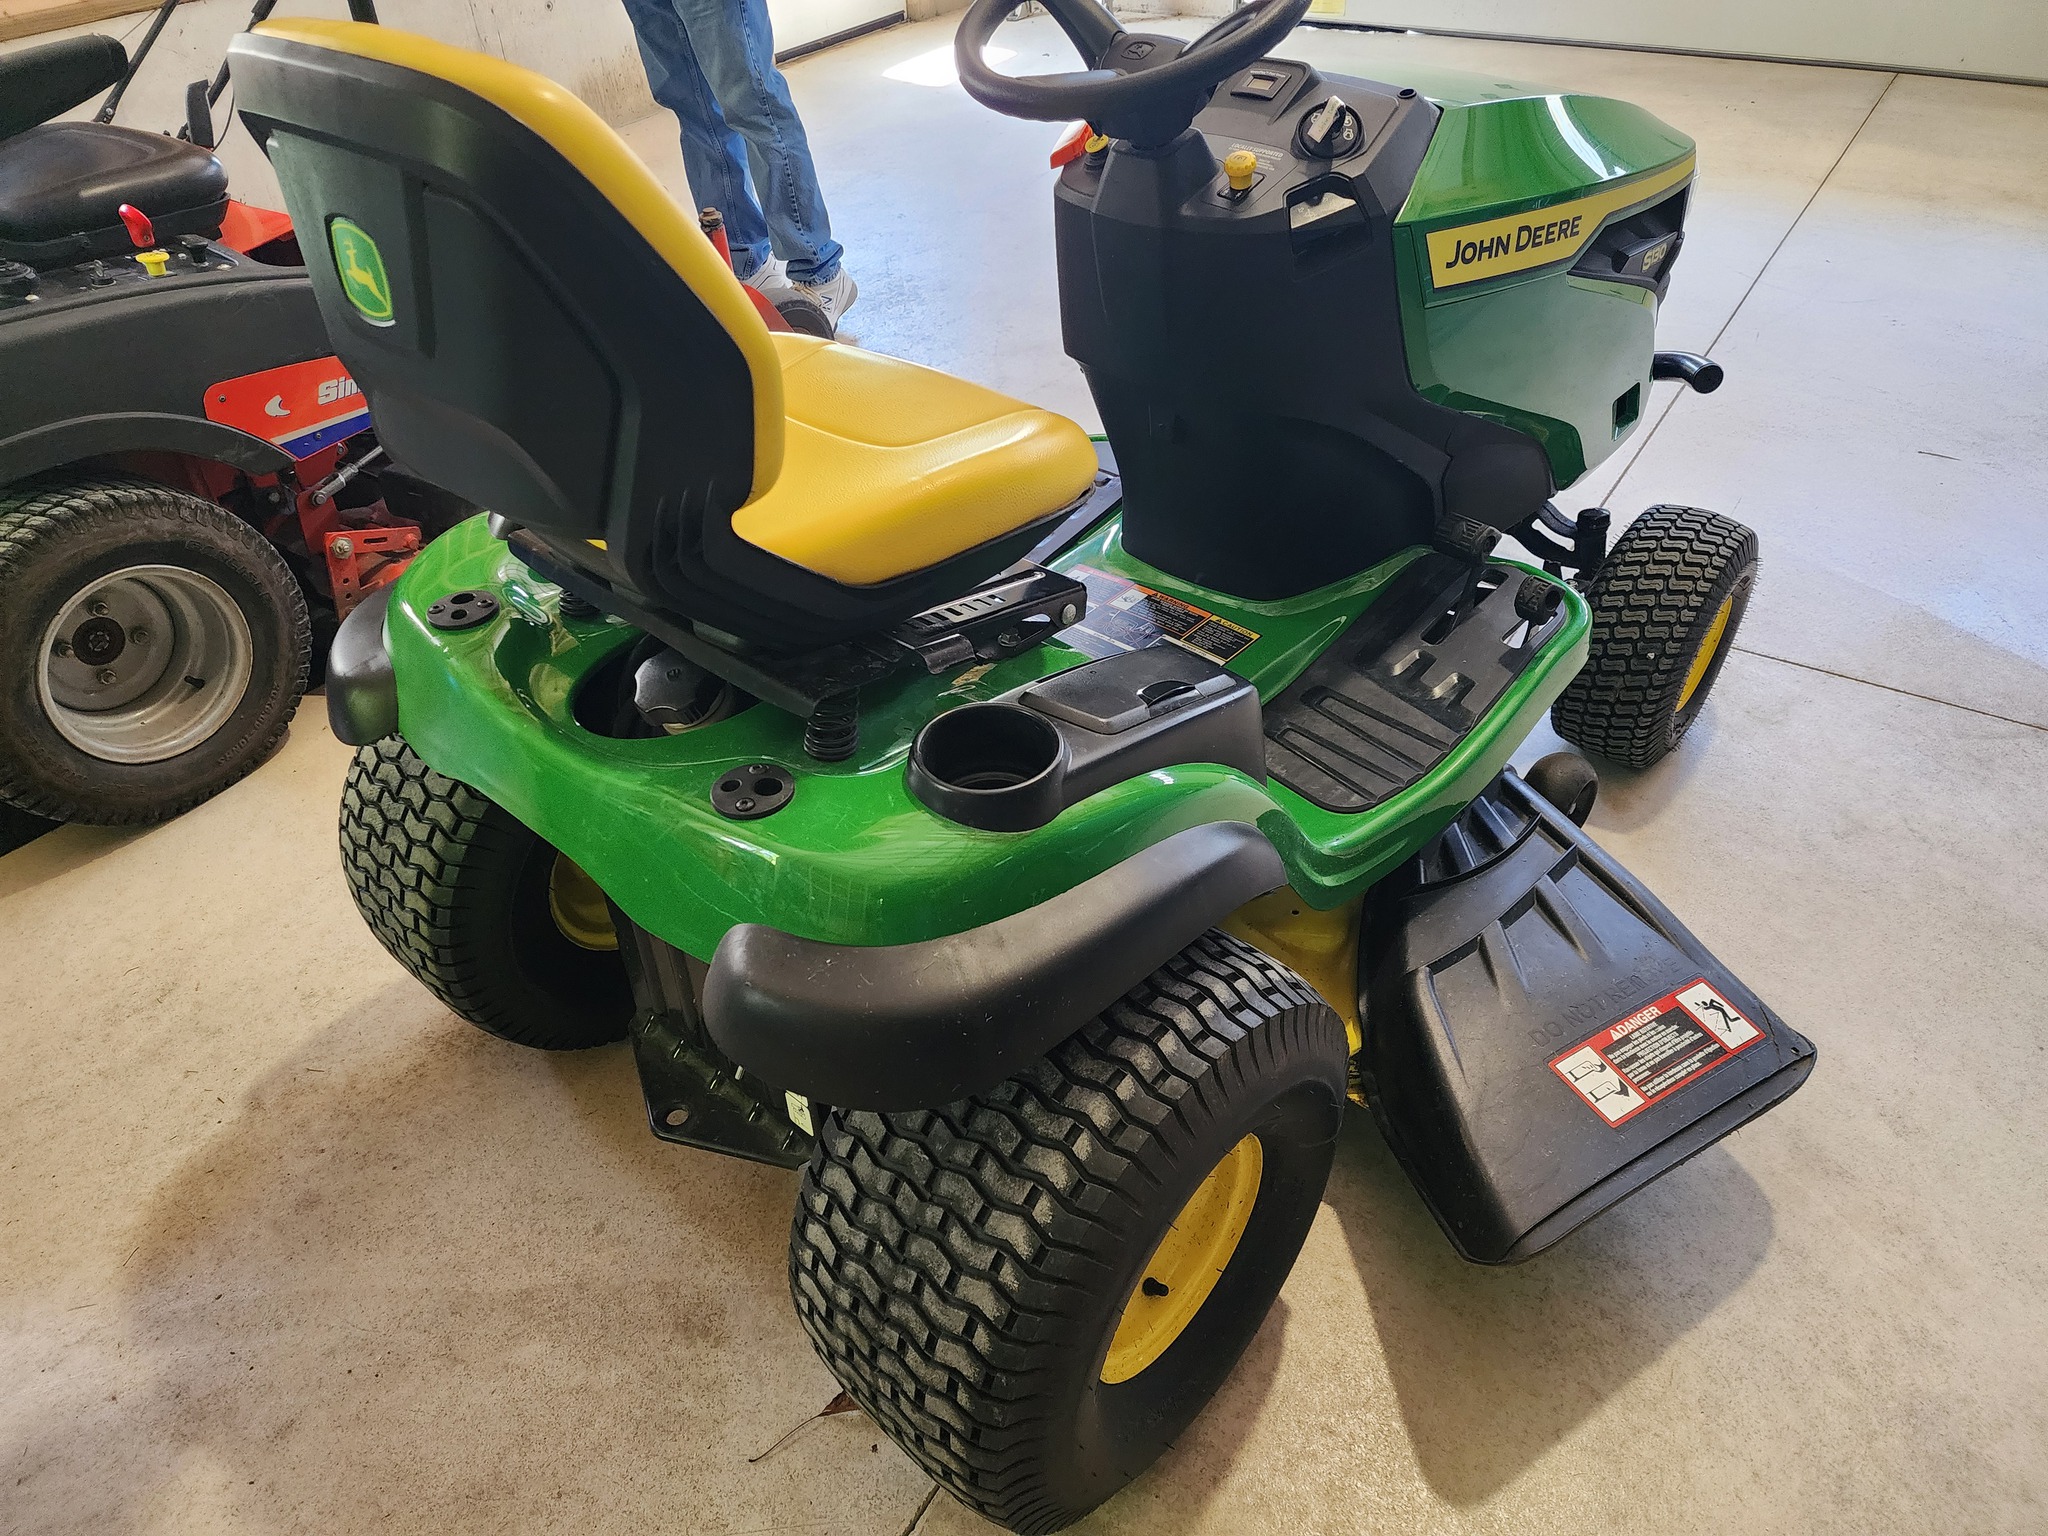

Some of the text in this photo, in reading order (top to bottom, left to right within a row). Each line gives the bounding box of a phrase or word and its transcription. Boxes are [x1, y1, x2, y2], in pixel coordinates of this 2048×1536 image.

[1252, 146, 1284, 158] SUPPORTED
[1446, 215, 1583, 269] JOHN DEERE
[1159, 594, 1190, 609] WARNING
[1222, 620, 1254, 637] CAUTION
[1615, 1006, 1663, 1036] DANGER
